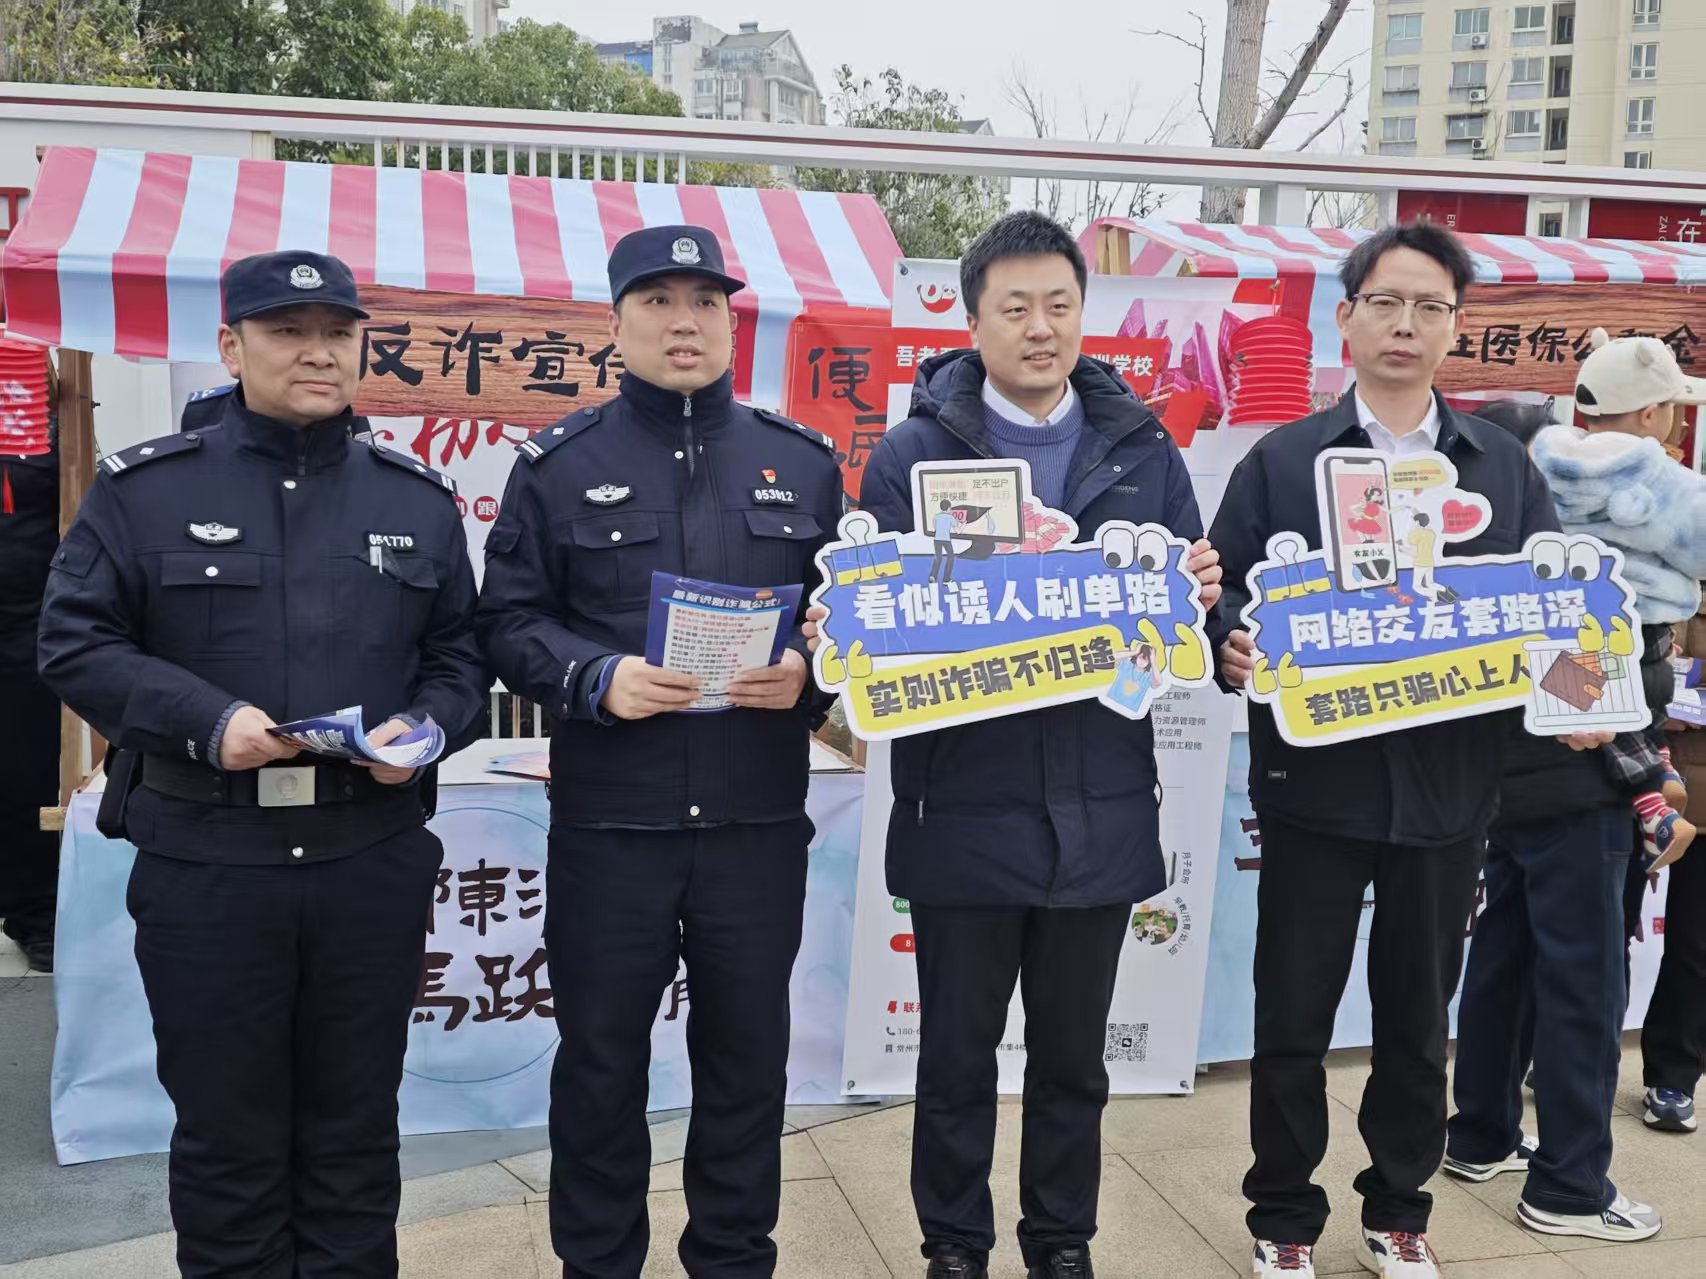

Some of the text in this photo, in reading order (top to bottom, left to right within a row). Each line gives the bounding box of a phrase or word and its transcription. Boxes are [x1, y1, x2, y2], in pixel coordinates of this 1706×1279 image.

[1447, 321, 1701, 366] 医保公金
[853, 572, 1172, 630] 看似诱人刷单路
[1289, 588, 1587, 652] 网络交友套路深
[866, 636, 1116, 717] 实则诈骗不归途
[1305, 653, 1531, 726] 套路只骗心上人
